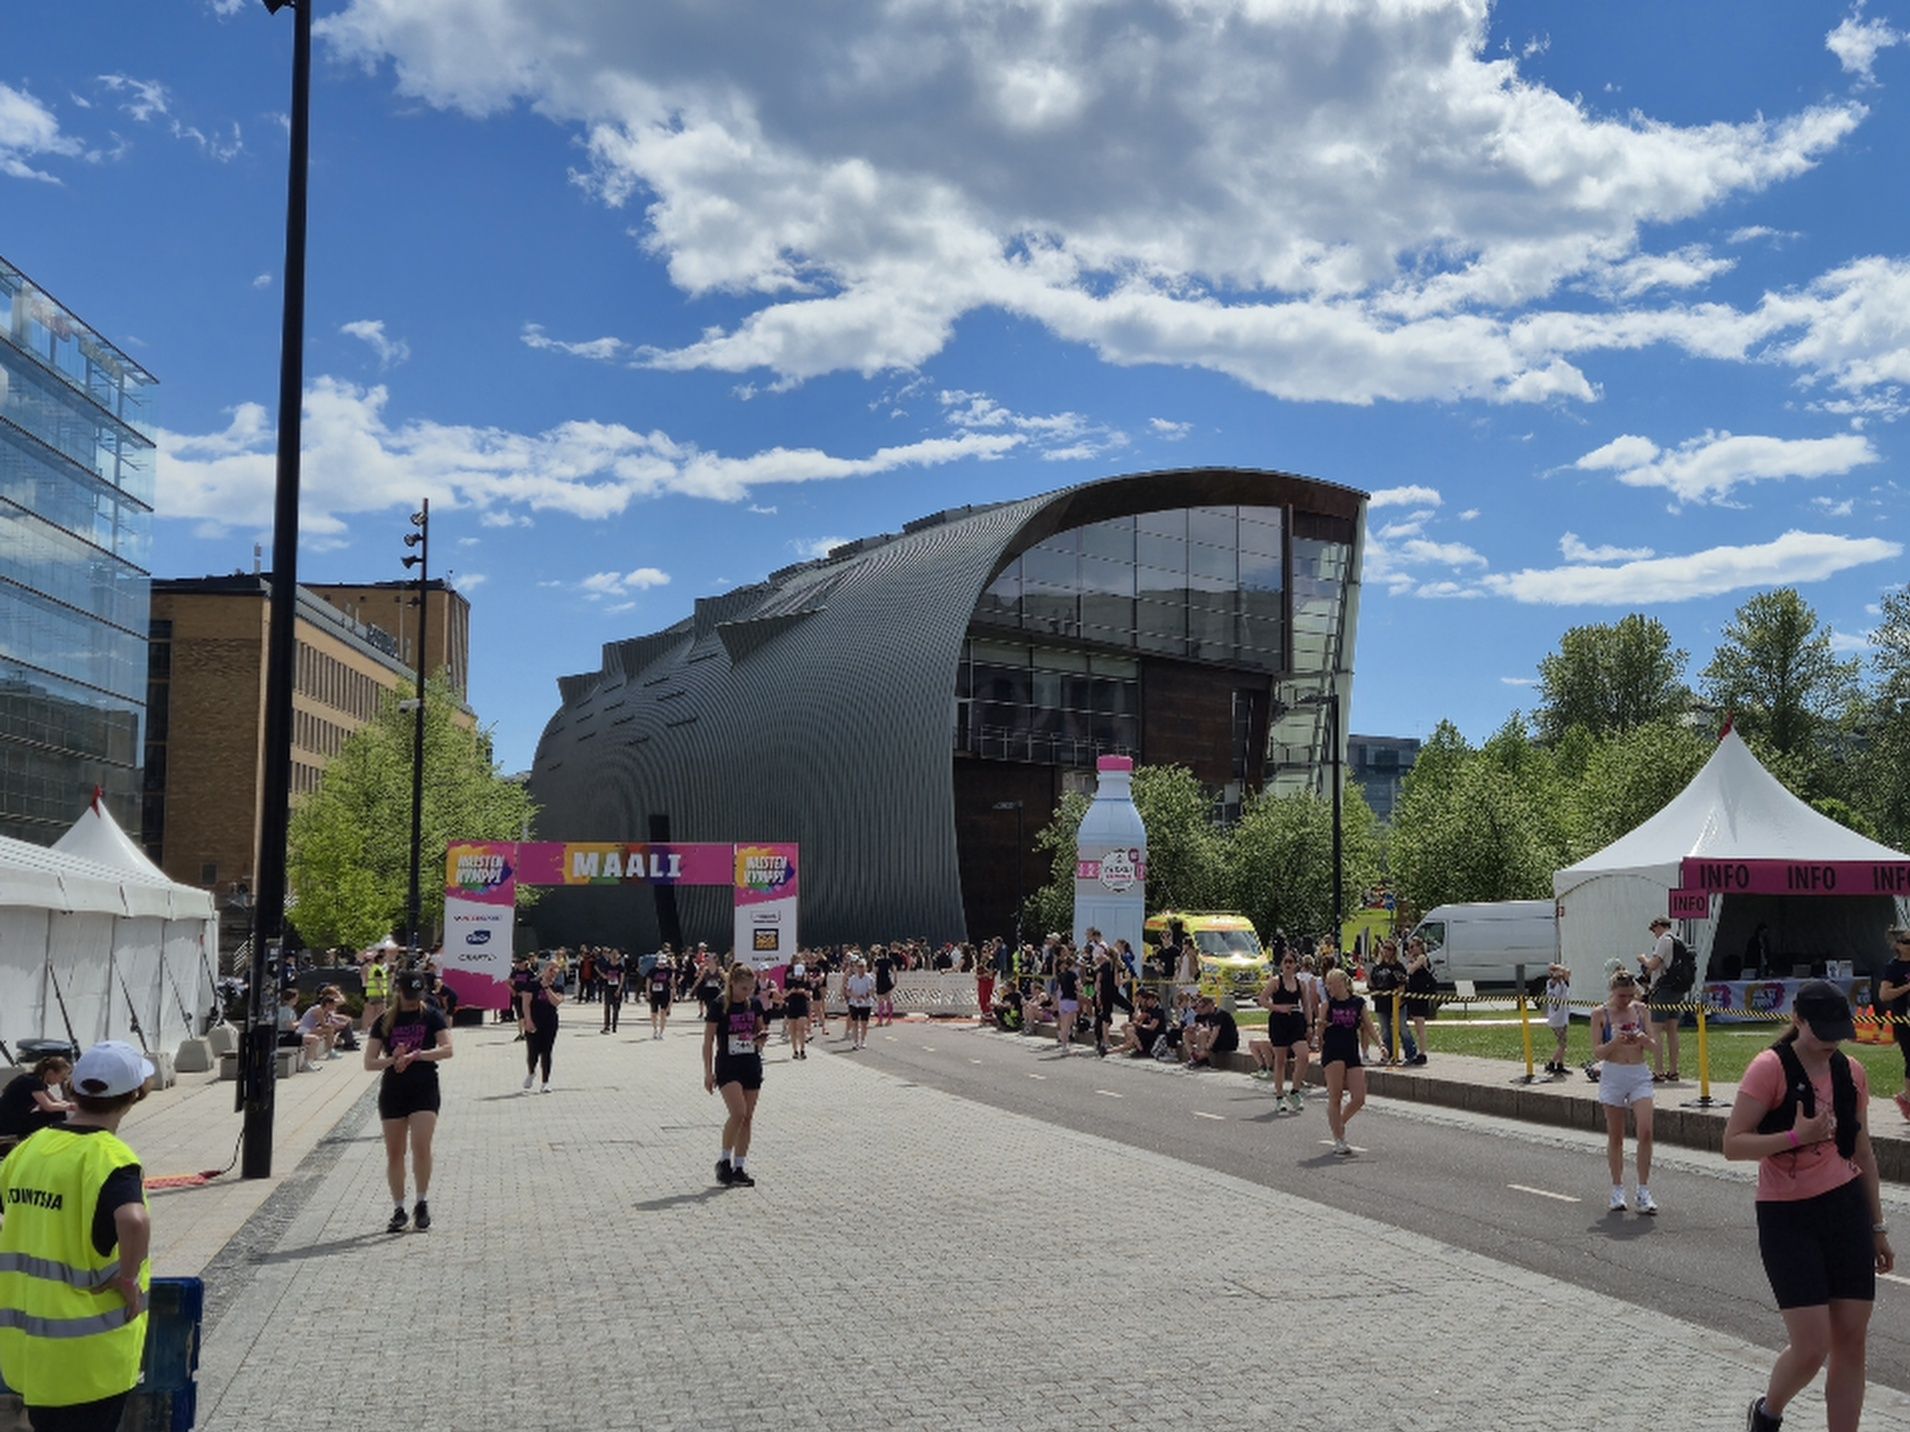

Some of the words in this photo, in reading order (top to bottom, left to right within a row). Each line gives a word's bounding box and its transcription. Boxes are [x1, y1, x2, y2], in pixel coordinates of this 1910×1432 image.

[573, 852, 681, 877] MAALI
[1700, 864, 1749, 889] INFO
[1788, 866, 1836, 890] INFO
[1673, 896, 1705, 911] INFO
